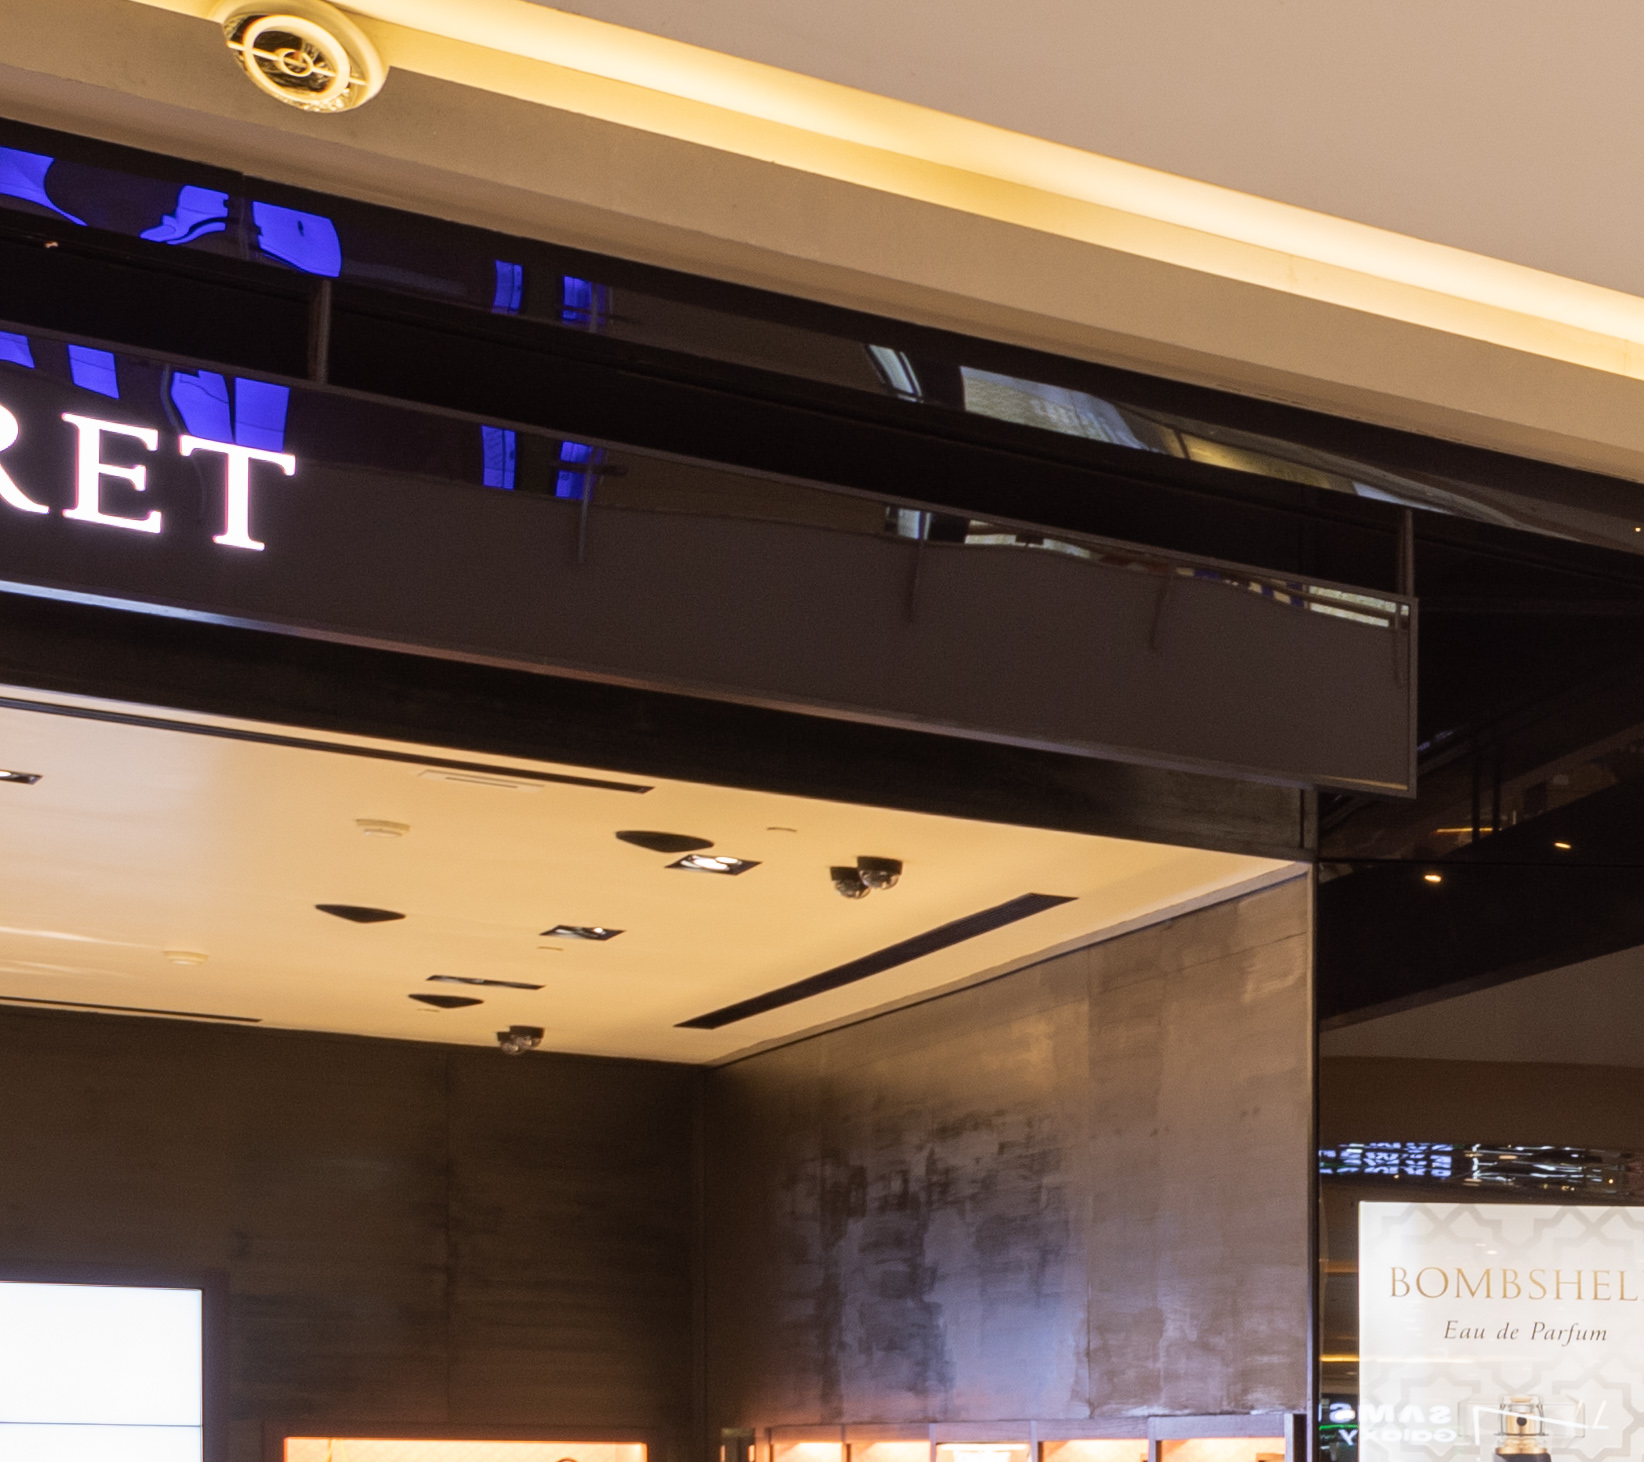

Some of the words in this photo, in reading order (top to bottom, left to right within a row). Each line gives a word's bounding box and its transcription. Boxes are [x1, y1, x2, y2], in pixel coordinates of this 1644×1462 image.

[1444, 1319, 1487, 1341] Eau
[1496, 1320, 1519, 1341] de
[1531, 1320, 1608, 1347] Parfum
